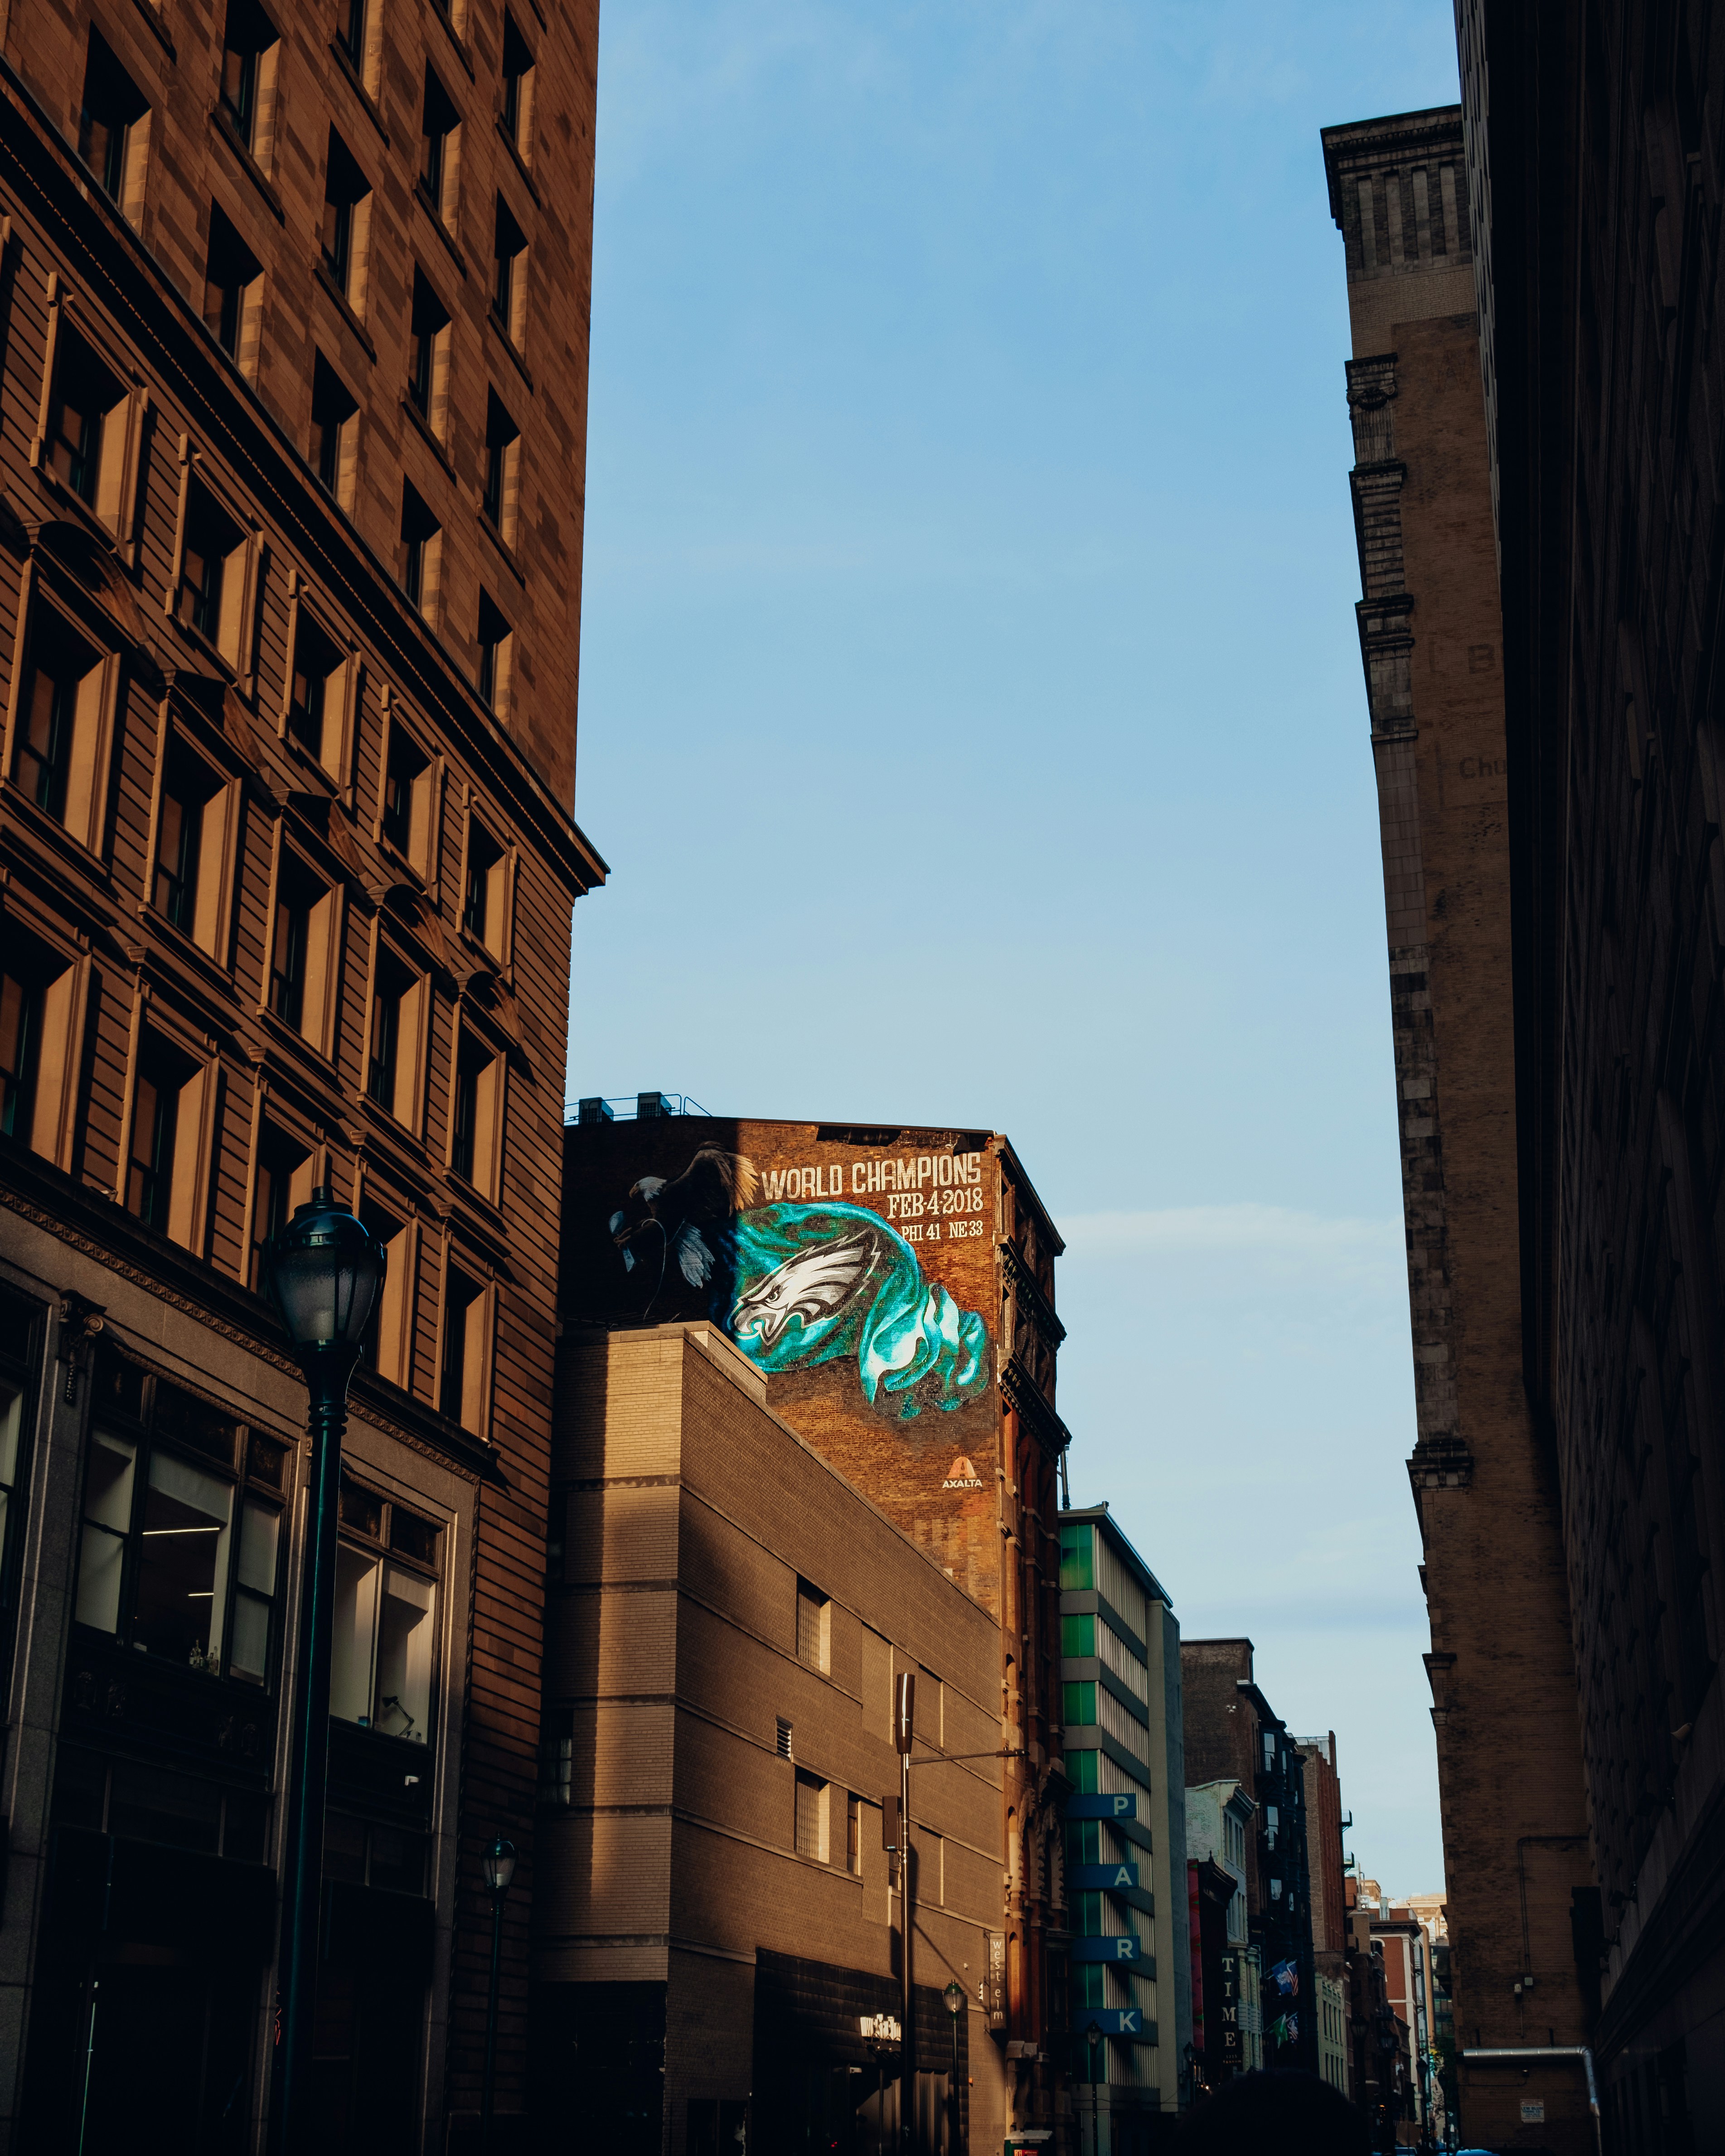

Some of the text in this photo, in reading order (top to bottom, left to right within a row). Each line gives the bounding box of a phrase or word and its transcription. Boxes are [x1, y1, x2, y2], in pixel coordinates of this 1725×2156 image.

[761, 1152, 981, 1200] WORLD CHAMPIONS
[901, 1220, 983, 1241] PHI 41 NE 33
[942, 1479, 983, 1488] AXALTA
[1114, 1796, 1136, 2031] PARK
[993, 1941, 1003, 2020] west elm
[1221, 1957, 1236, 2047] TIME
